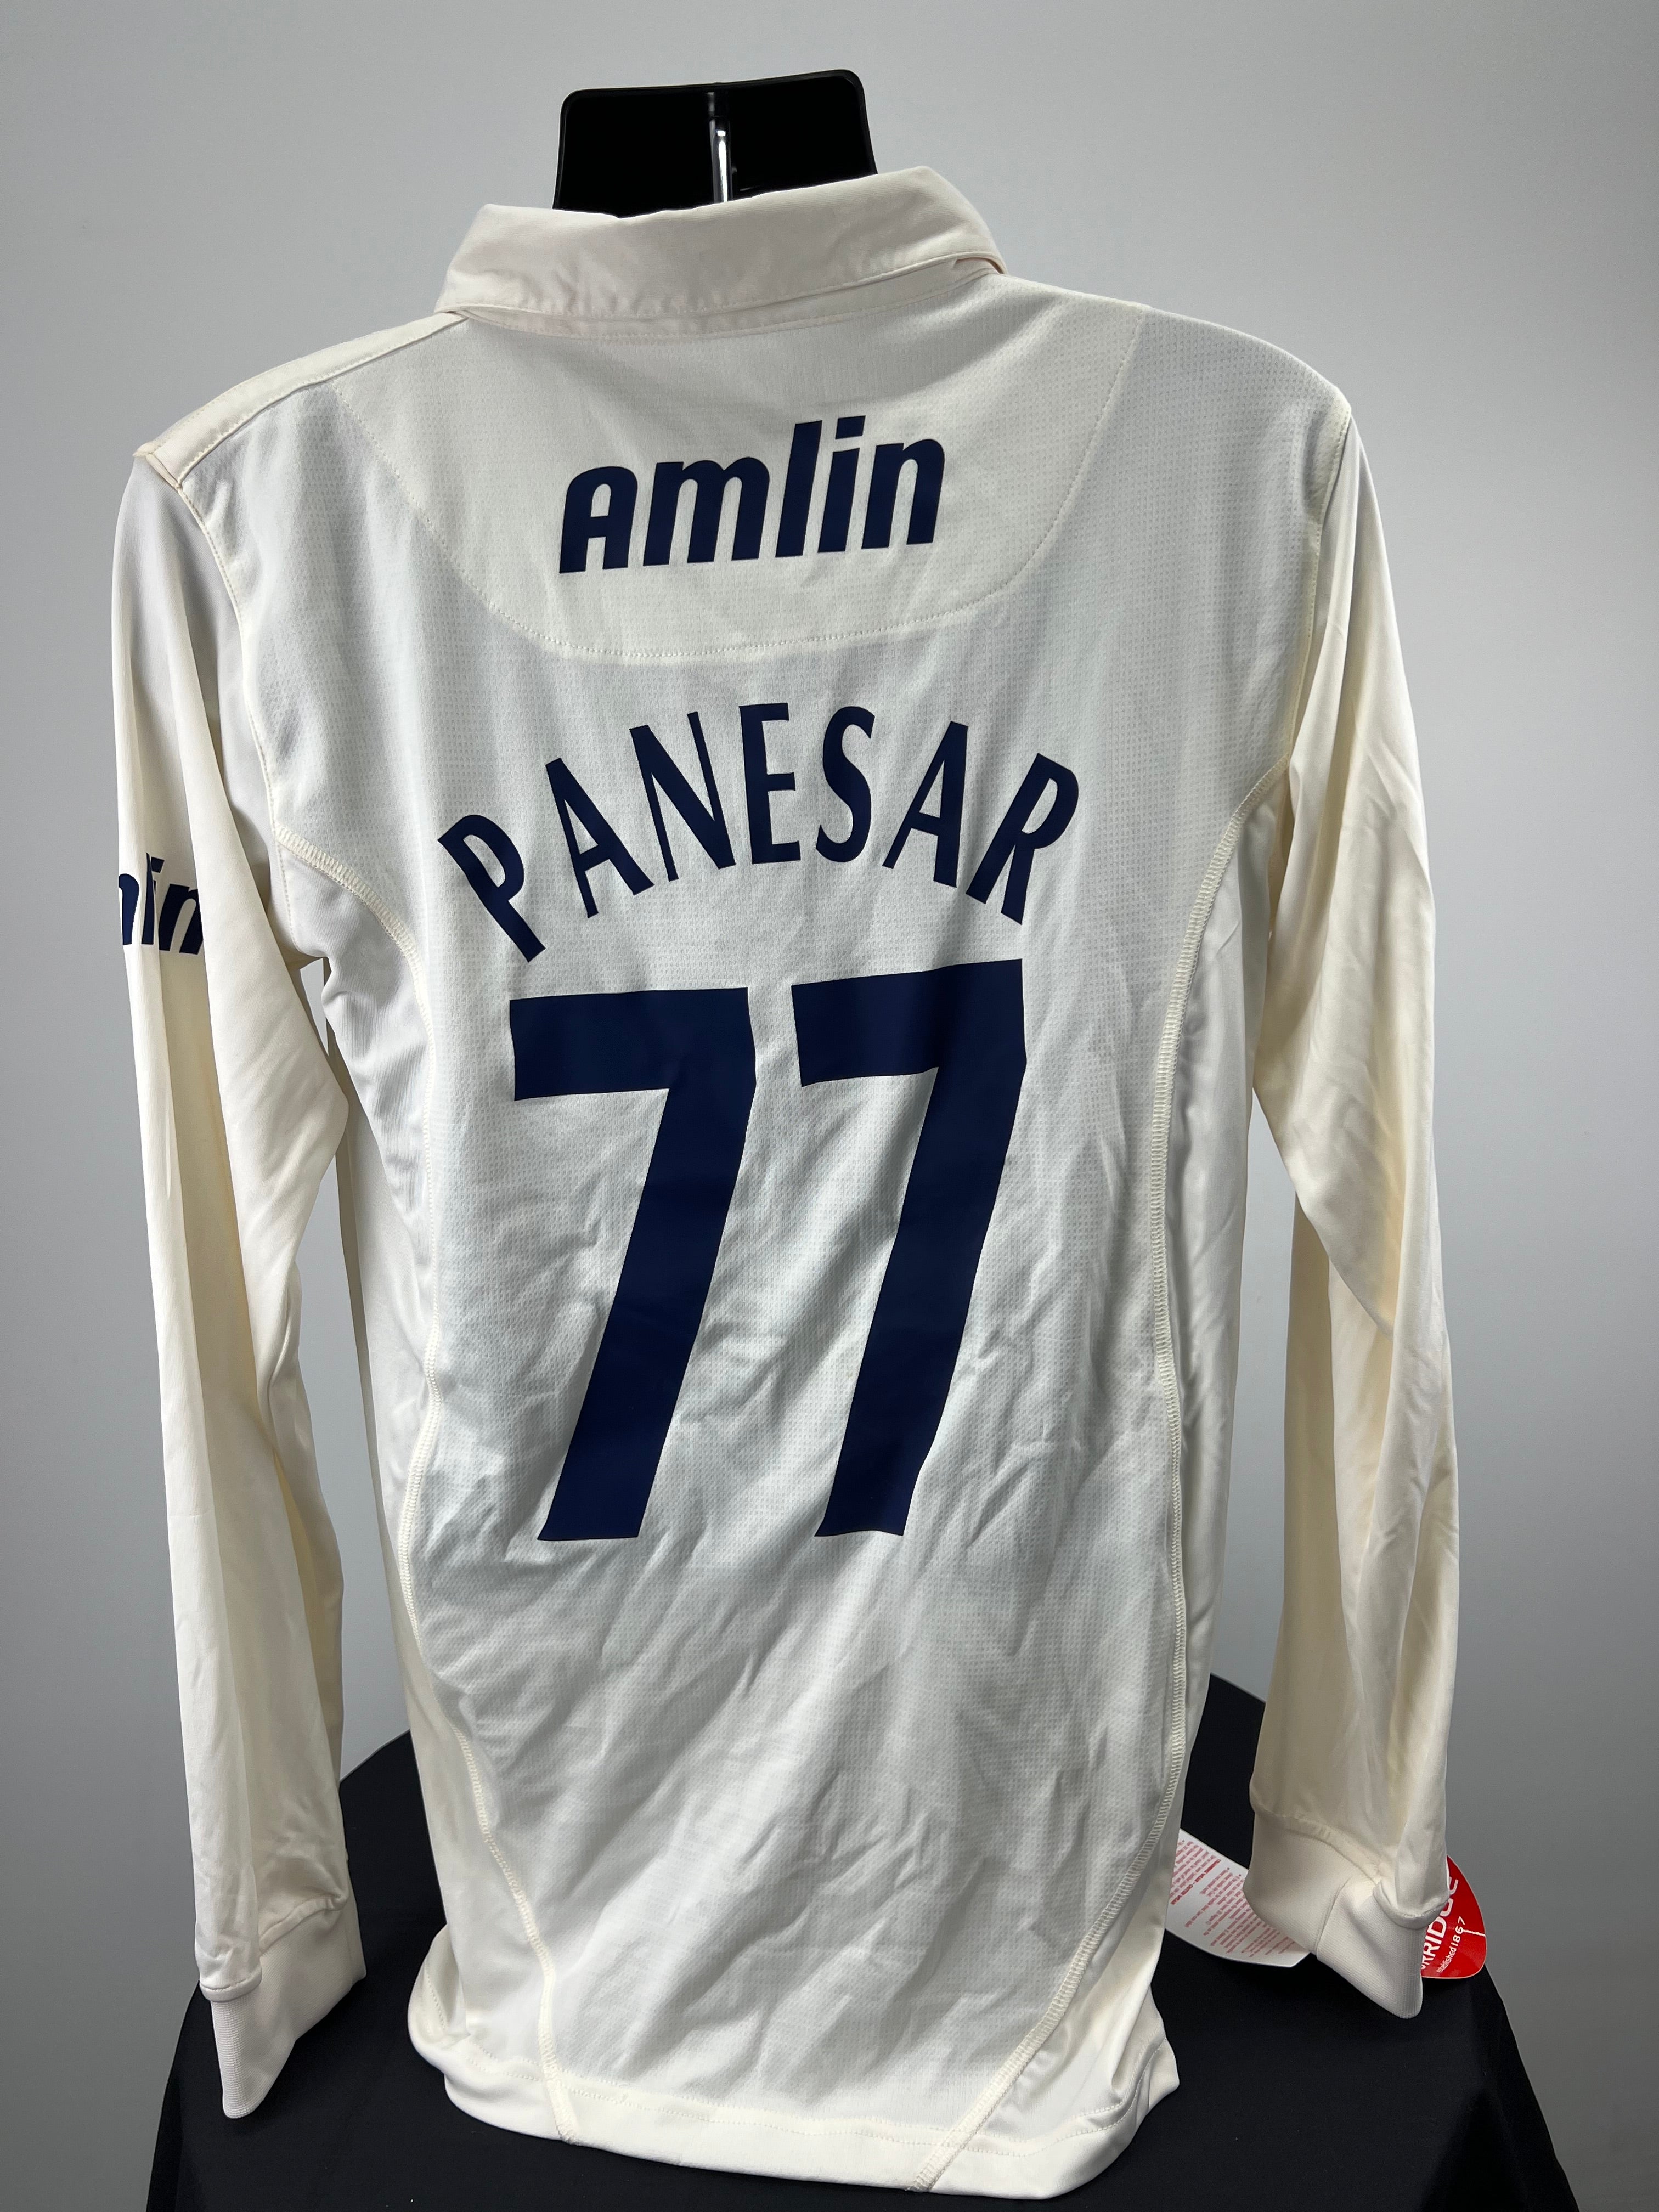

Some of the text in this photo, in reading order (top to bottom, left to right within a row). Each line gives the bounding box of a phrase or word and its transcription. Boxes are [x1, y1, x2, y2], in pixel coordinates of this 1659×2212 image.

[559, 415, 945, 574] amlin
[437, 702, 1079, 962] PANESAR
[509, 958, 1028, 1542] 77
[1451, 1915, 1465, 1947] 1867
